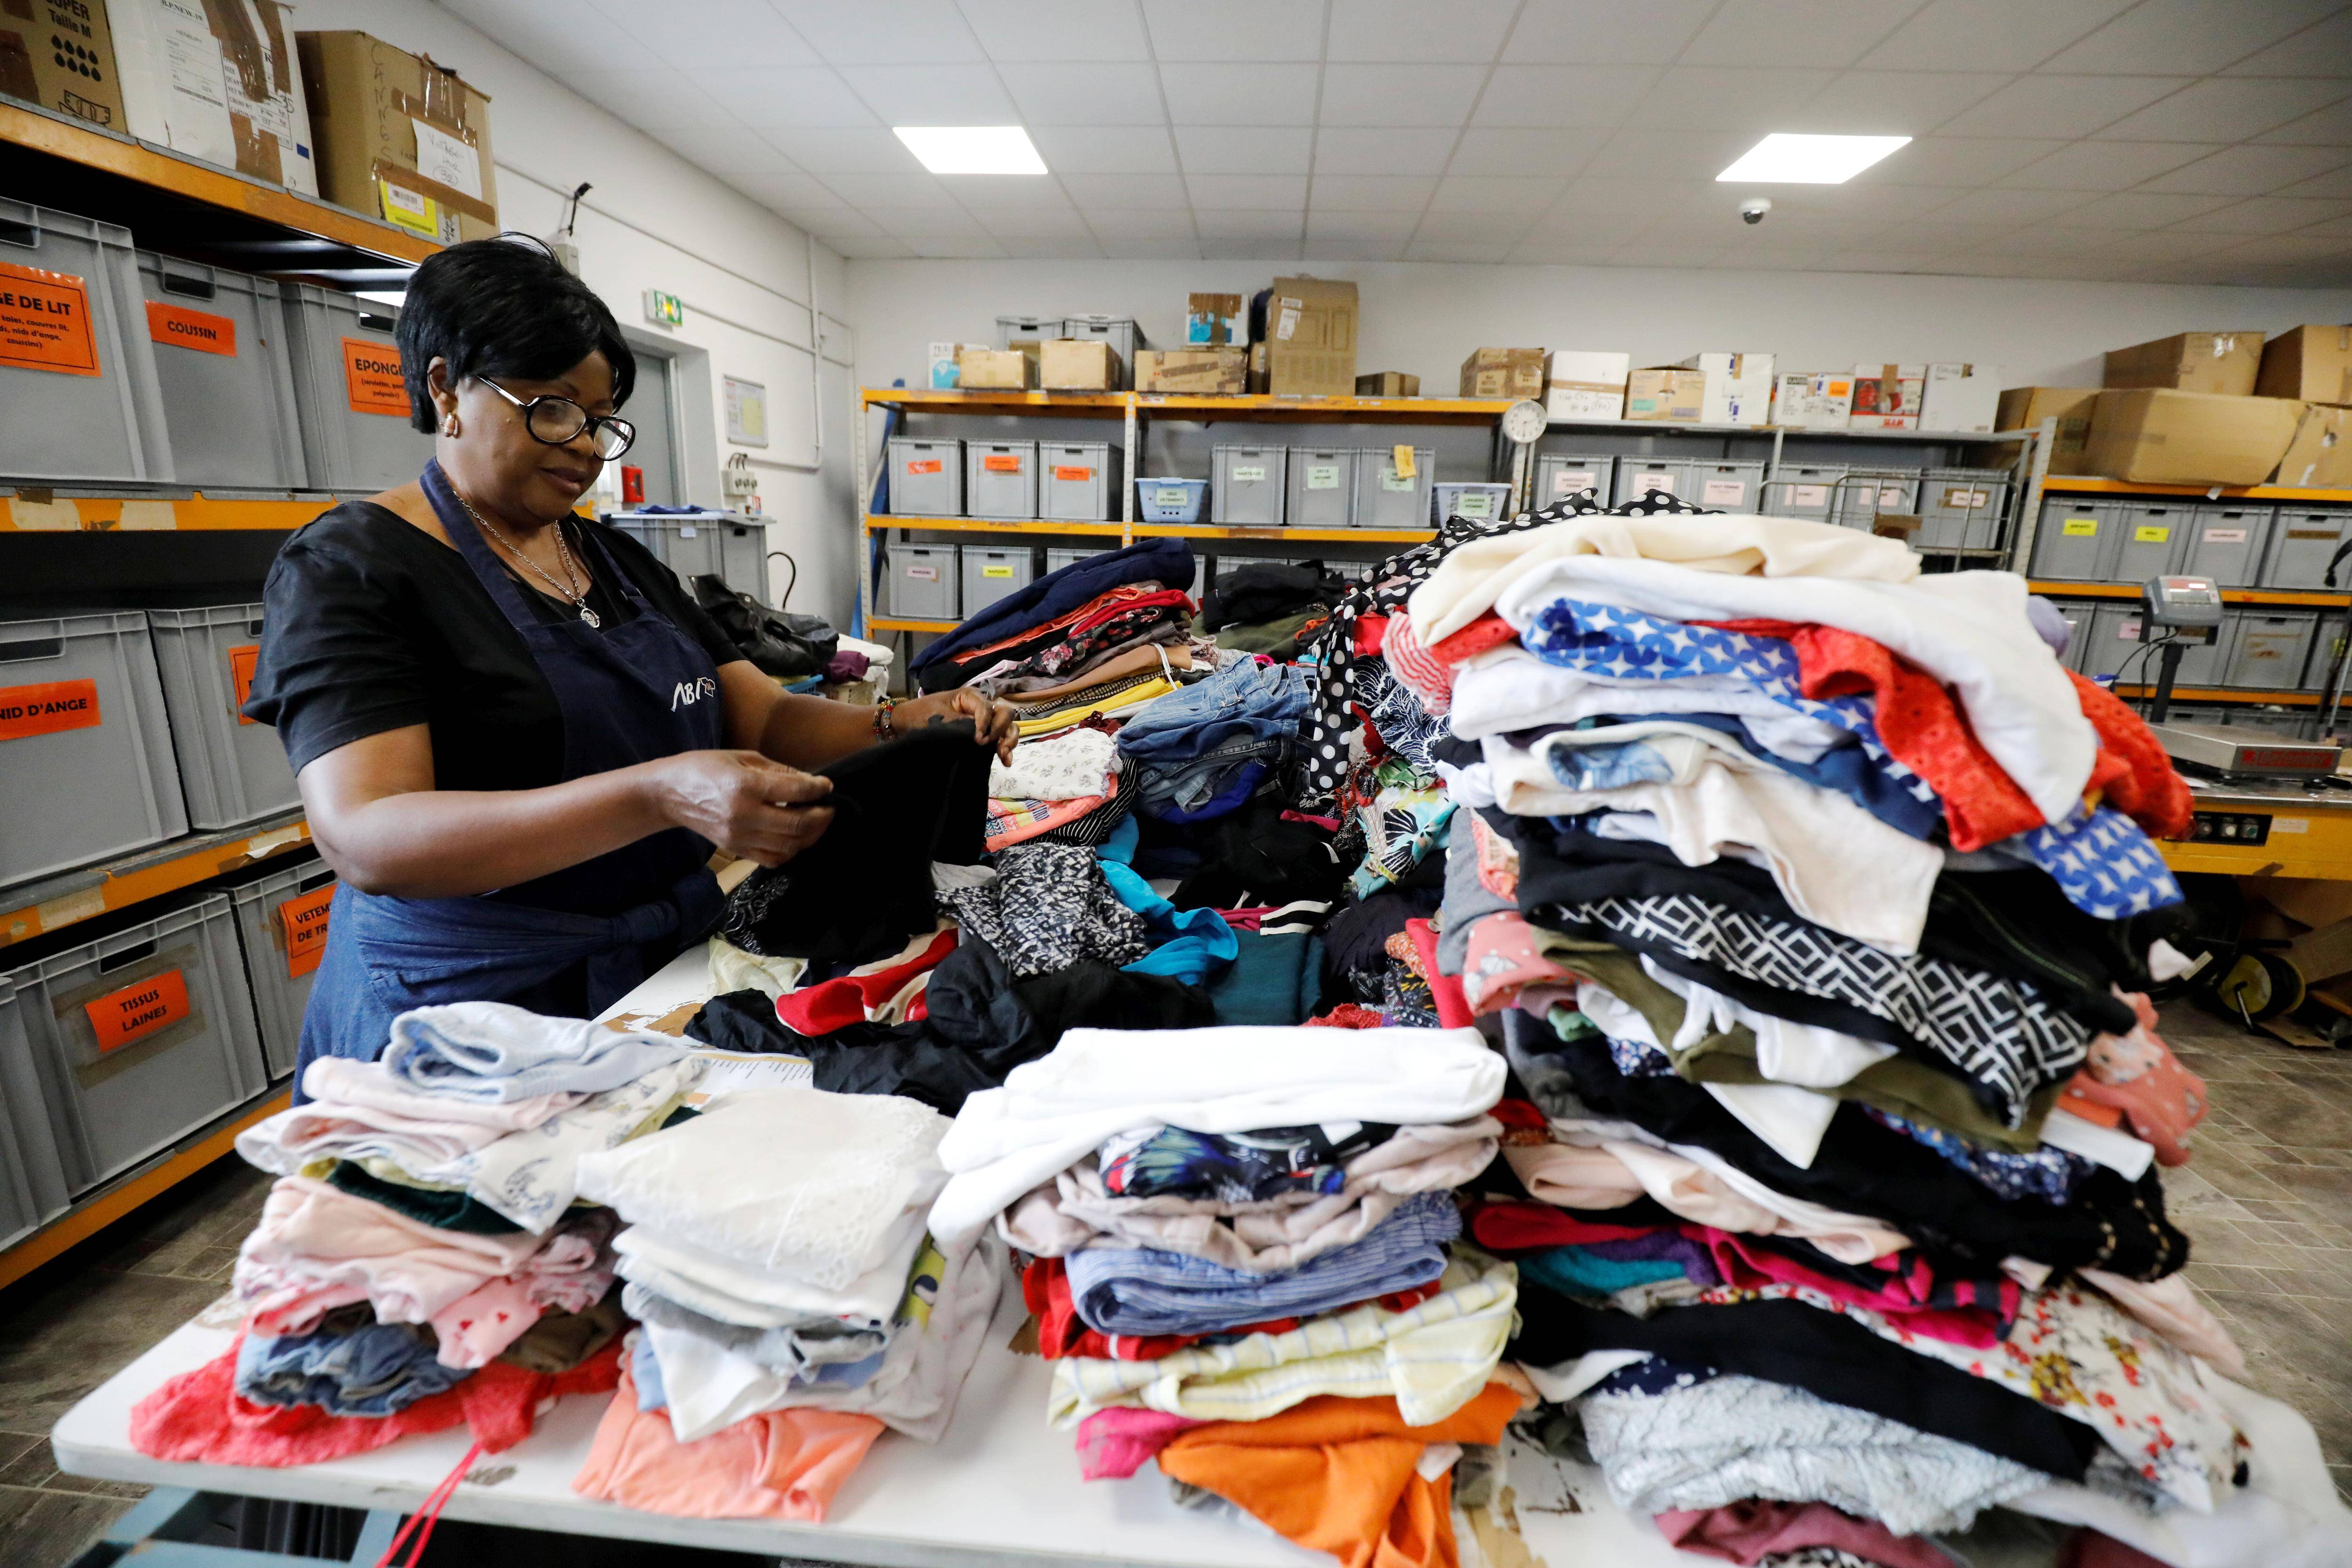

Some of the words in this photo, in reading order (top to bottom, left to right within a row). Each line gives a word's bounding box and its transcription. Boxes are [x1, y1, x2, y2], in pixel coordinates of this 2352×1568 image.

[19, 295, 43, 311] DE
[47, 300, 72, 316] LIT
[26, 319, 56, 329] couvres
[167, 320, 217, 340] COUSSIN
[28, 698, 88, 716] D'ANGE
[295, 902, 332, 924] VETEM
[297, 929, 312, 943] DE
[120, 989, 160, 1013] TISSUS
[121, 1004, 168, 1032] LAINES
